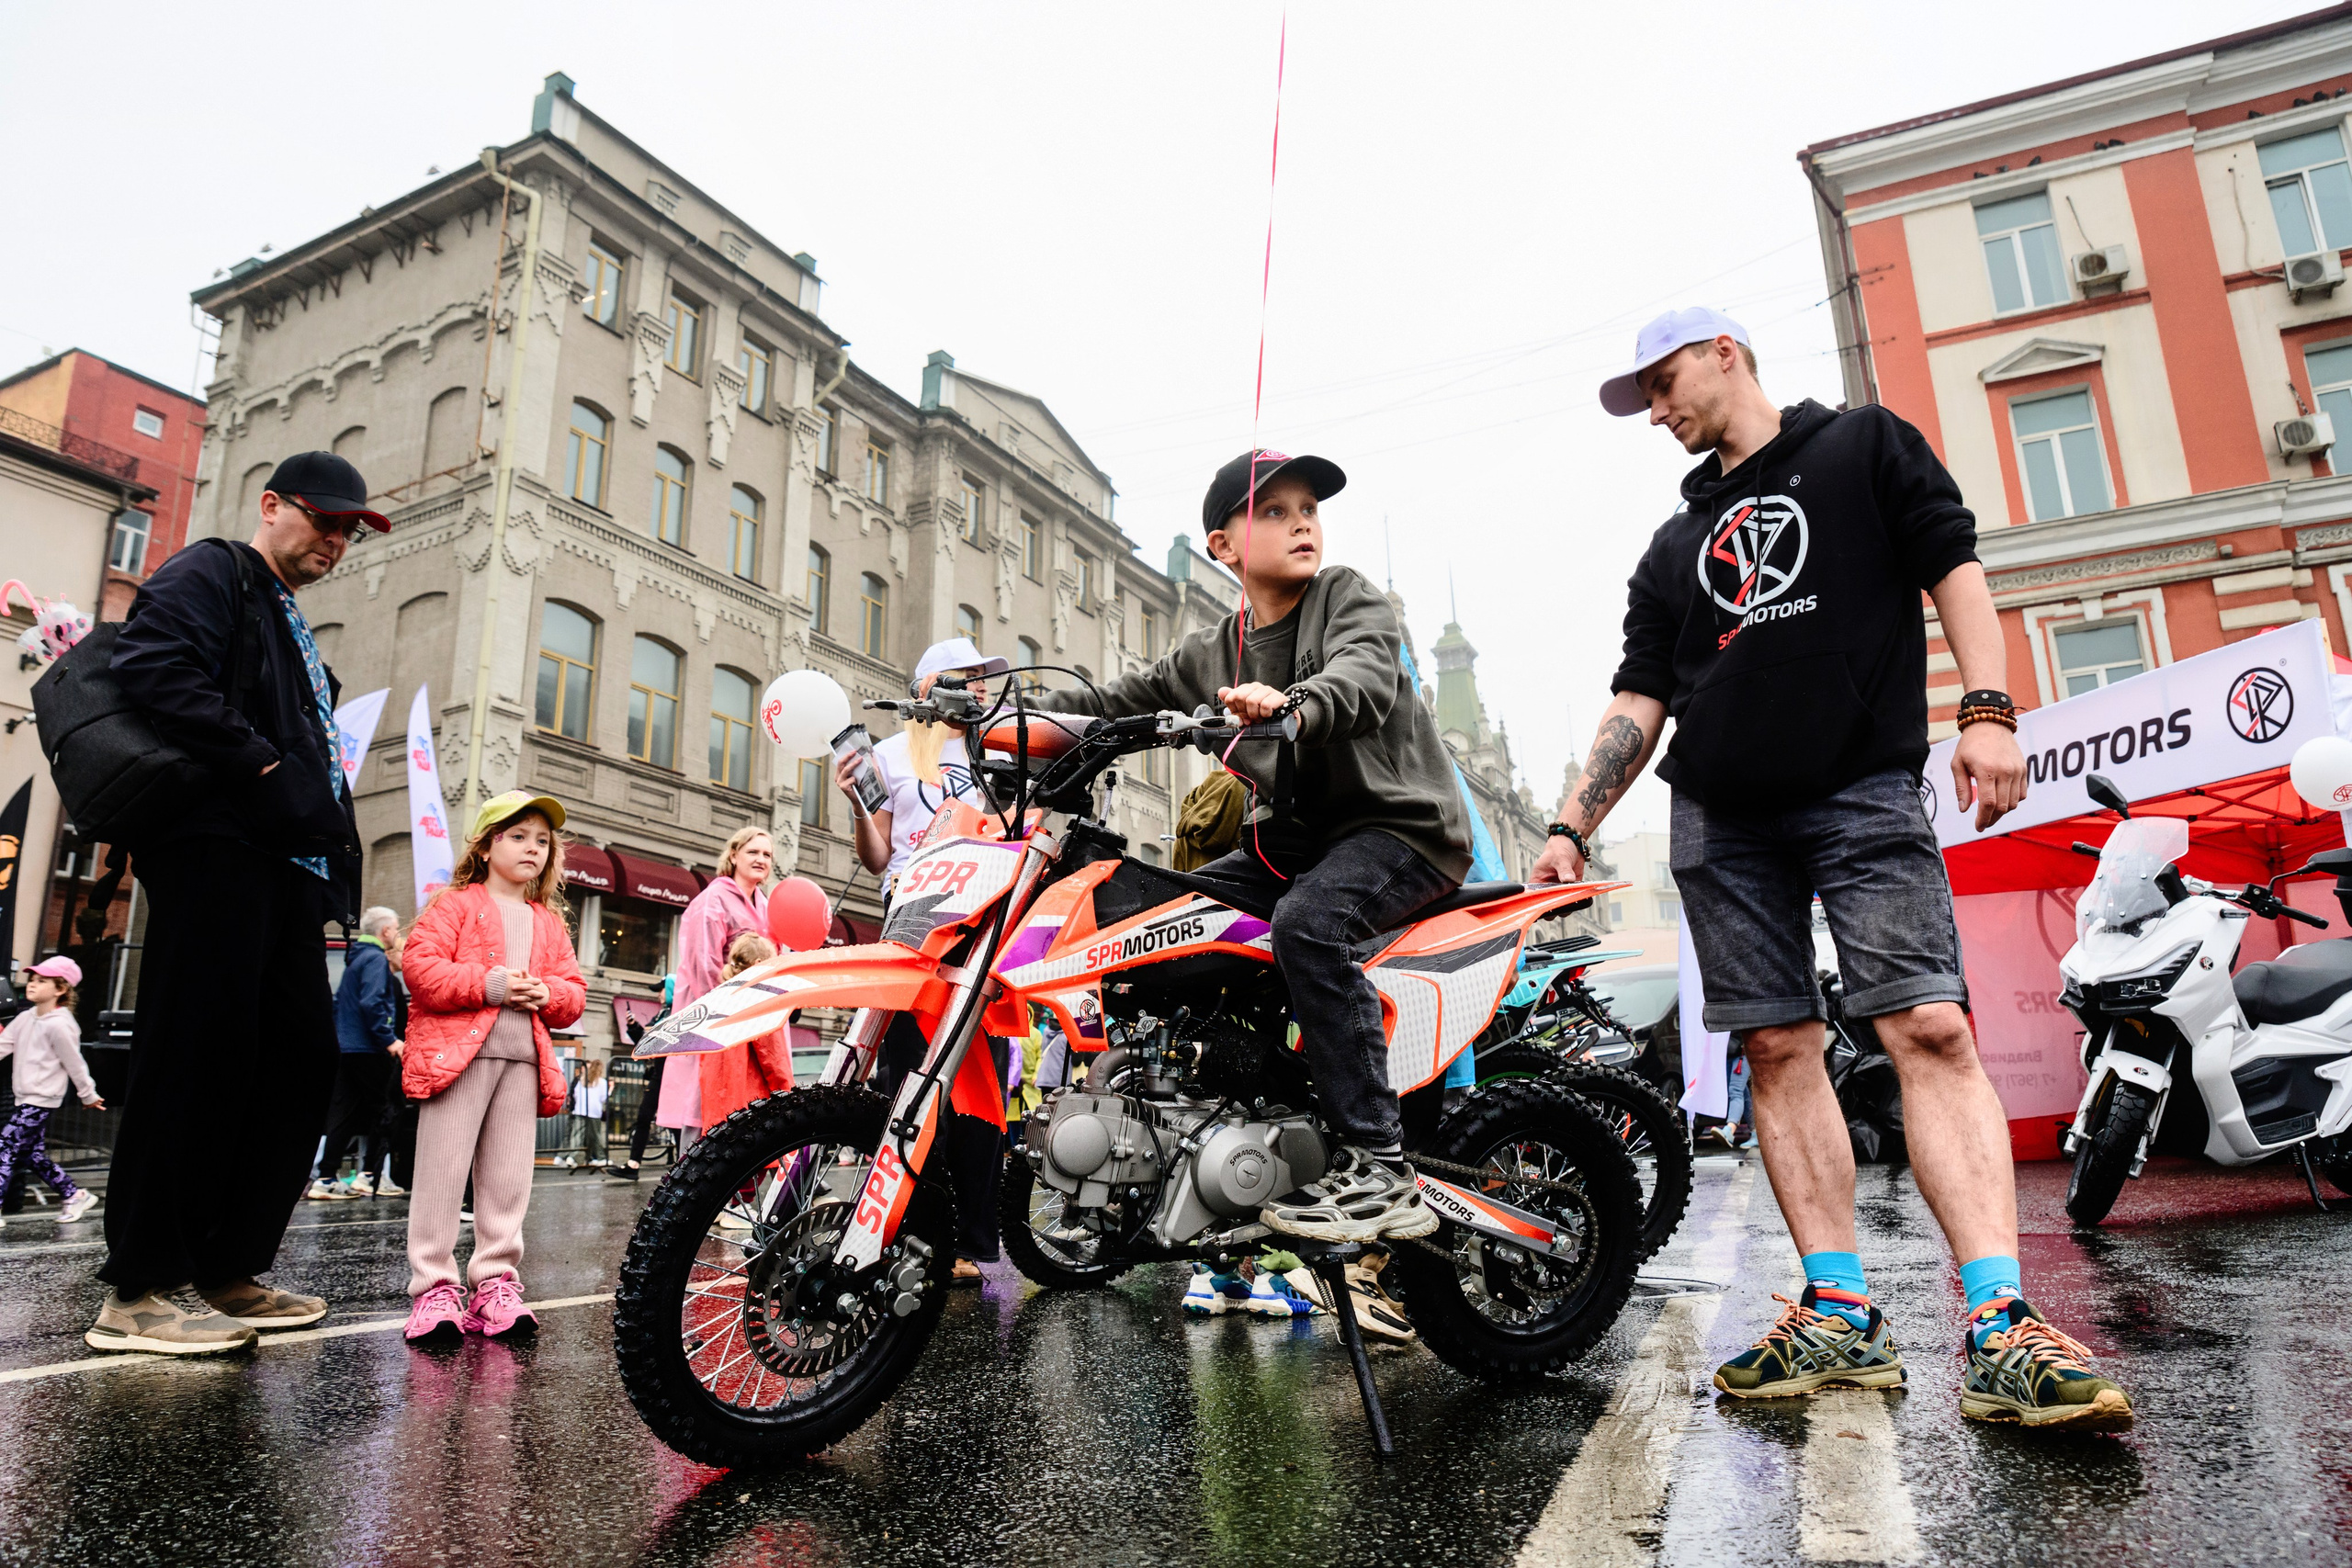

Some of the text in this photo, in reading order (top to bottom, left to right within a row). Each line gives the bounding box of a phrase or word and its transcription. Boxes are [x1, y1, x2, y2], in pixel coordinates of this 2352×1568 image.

[2026, 707, 2192, 784] MOTORS
[902, 860, 979, 895] SPR
[1086, 917, 1204, 970] SPRMOTORS
[1229, 1148, 1268, 1167] SPRMOTORS
[856, 1145, 903, 1235] SPR
[1416, 1177, 1476, 1222] RMOTORS
